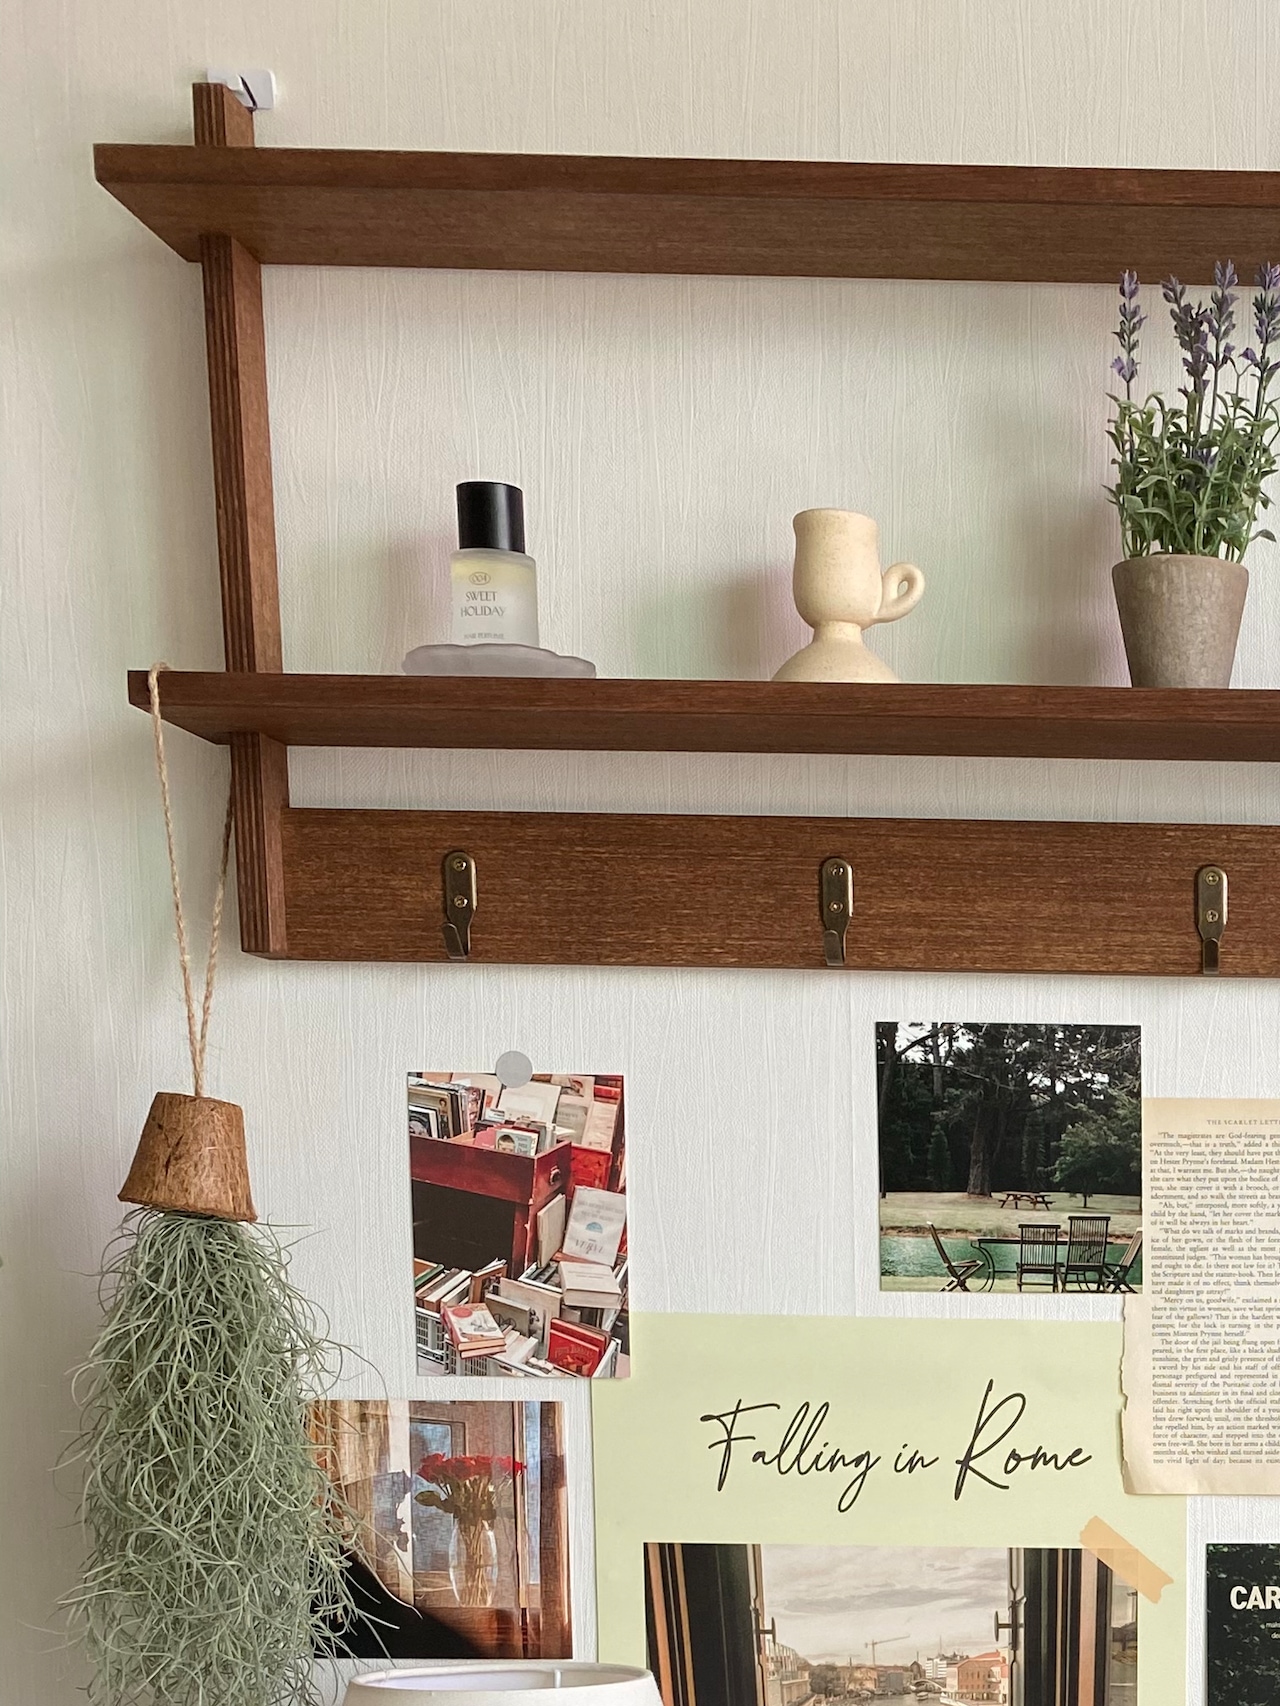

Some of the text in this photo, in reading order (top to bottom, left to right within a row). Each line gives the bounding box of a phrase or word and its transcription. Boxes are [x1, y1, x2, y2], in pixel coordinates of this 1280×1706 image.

[465, 591, 497, 601] SWEET
[460, 606, 506, 617] HOLIDAY
[700, 1378, 1092, 1513] Falling in Rome
